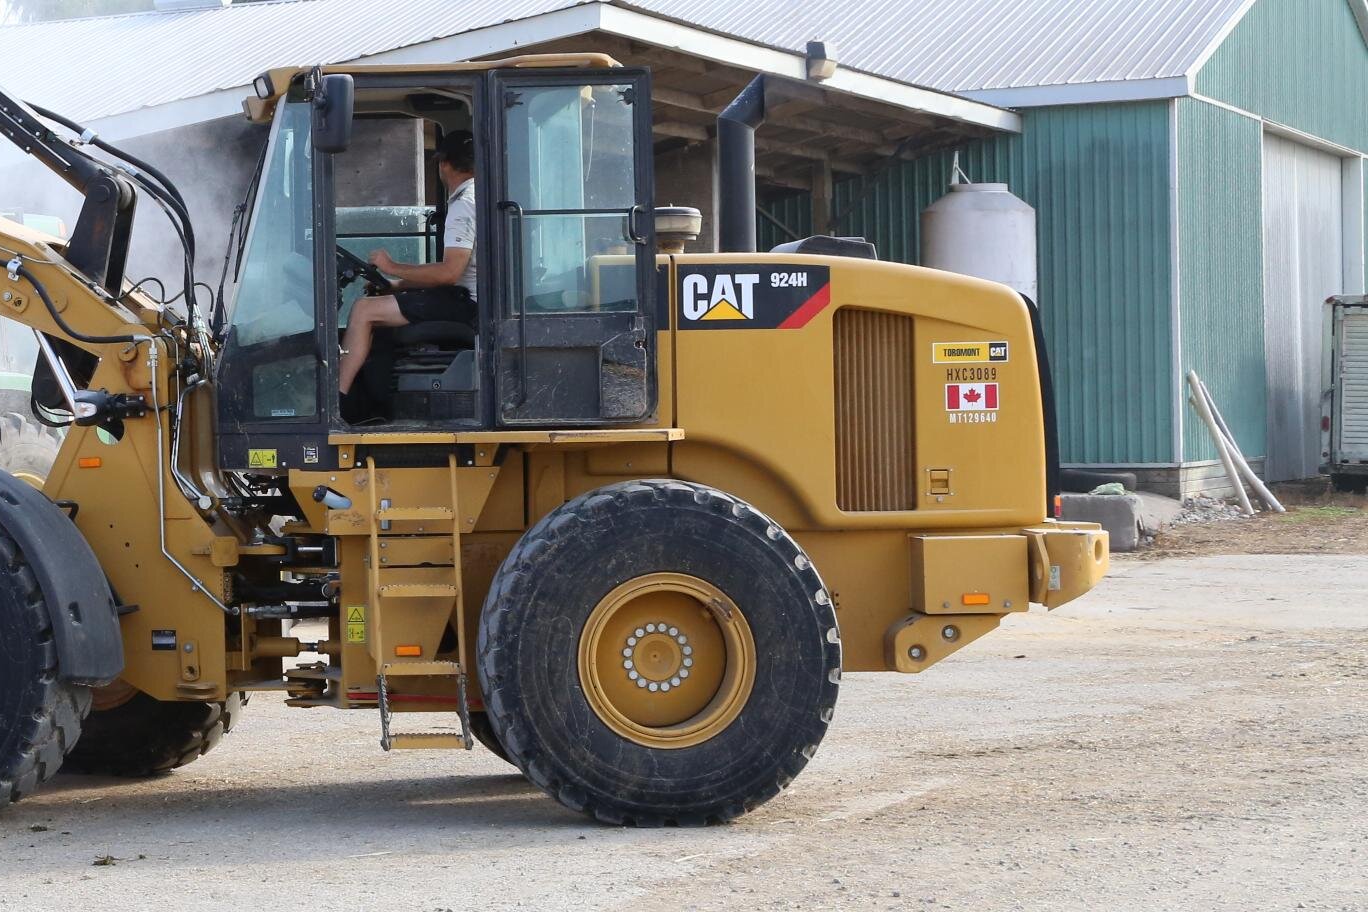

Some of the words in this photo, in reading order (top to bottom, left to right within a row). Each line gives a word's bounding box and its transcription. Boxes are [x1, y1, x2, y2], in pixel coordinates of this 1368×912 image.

[682, 273, 760, 321] CAT
[770, 272, 808, 288] 924H
[943, 348, 980, 357] TOROMONT
[990, 346, 1006, 357] CAT
[946, 367, 997, 381] HXC3089
[949, 412, 997, 423] MT129640
